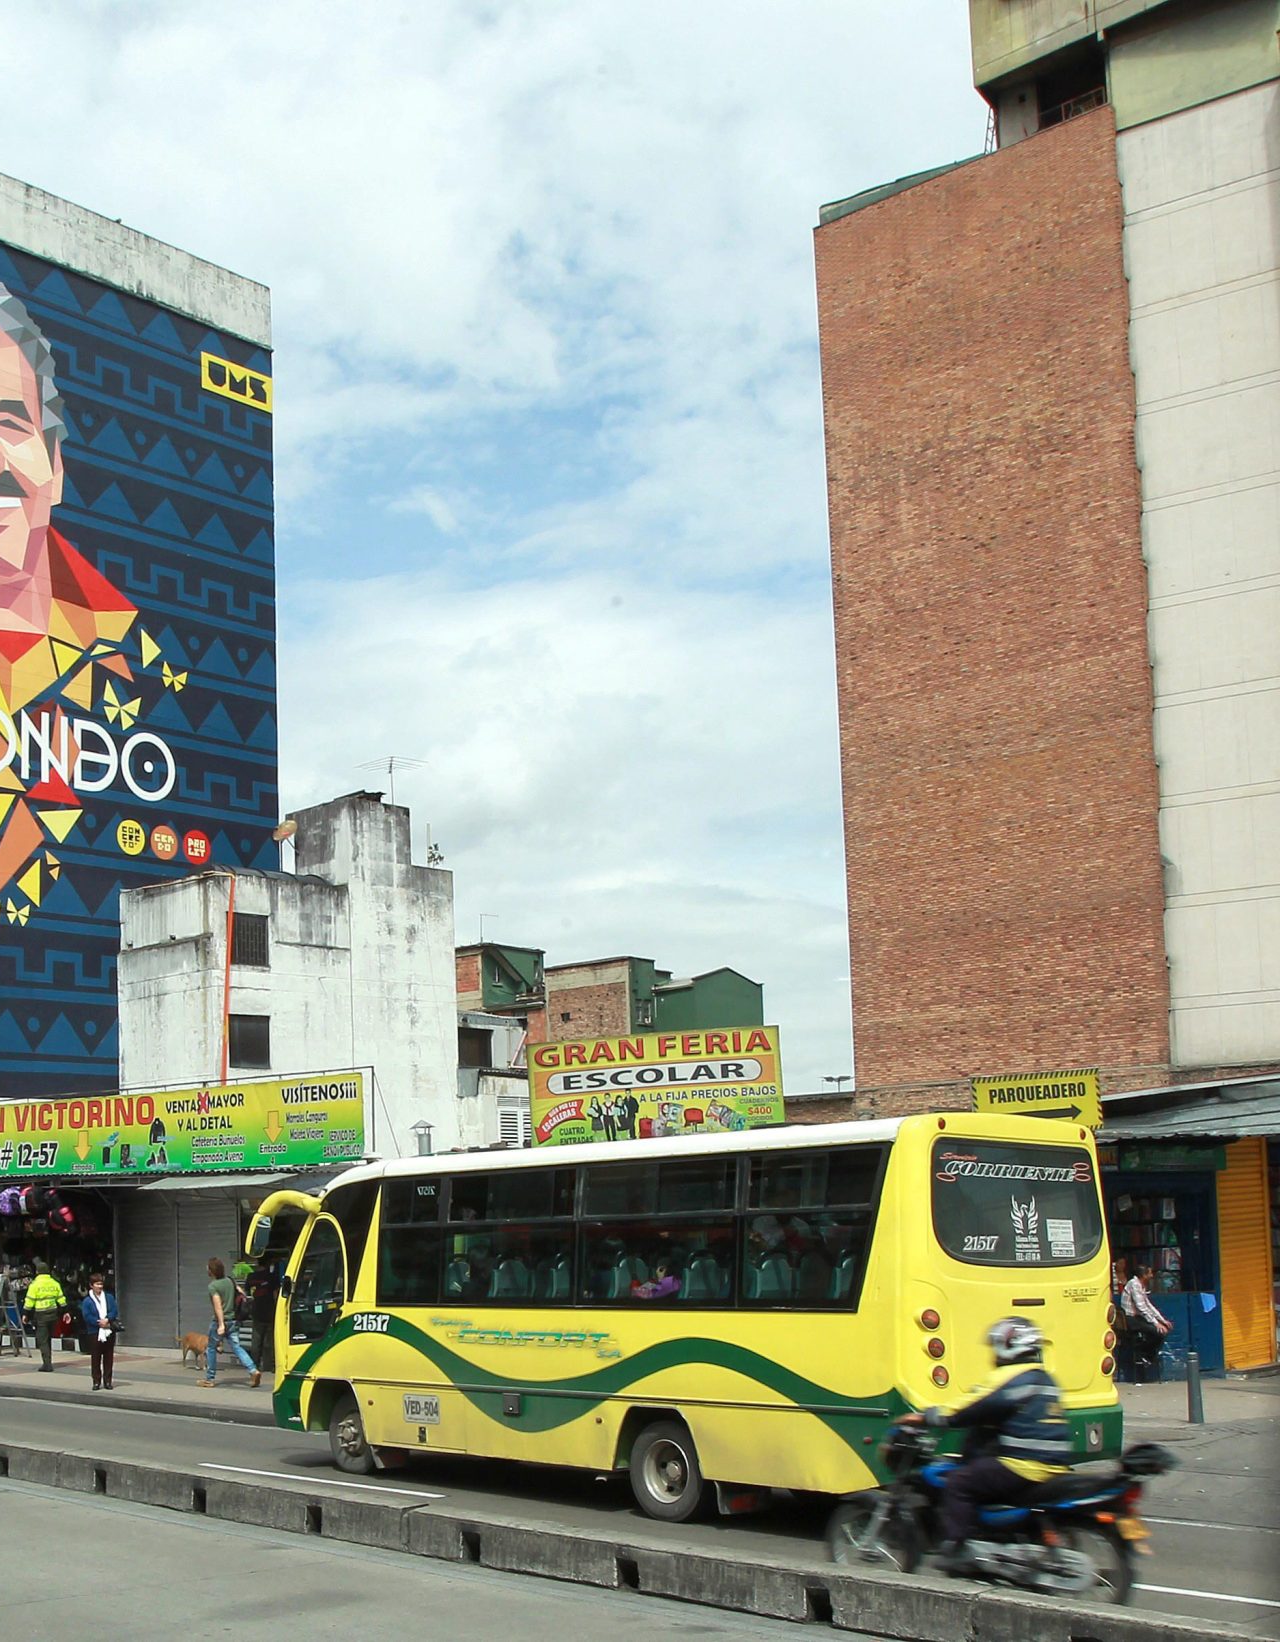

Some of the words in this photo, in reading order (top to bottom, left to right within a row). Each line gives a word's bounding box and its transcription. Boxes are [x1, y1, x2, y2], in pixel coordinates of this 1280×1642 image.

[534, 1036, 644, 1068] GRAN
[657, 1029, 772, 1057] FERIA
[563, 1062, 745, 1091] ESCOLAR
[207, 1093, 244, 1108] MAYOR
[640, 1094, 647, 1102] A
[649, 1093, 663, 1101] LA
[666, 1090, 688, 1101] FIJA
[691, 1087, 738, 1099] PRECIOS
[741, 1085, 777, 1096] BAJOS
[989, 1082, 1087, 1104] PARQUEADERO
[14, 1096, 155, 1132] VICTORINO
[748, 1106, 772, 1115] $400
[177, 1119, 184, 1132] Y
[186, 1118, 198, 1131] AL
[200, 1115, 233, 1130] DETAL
[17, 1143, 58, 1167] 12-57
[945, 1160, 1077, 1182] CORRIENTE
[963, 1236, 999, 1252] 21517
[353, 1313, 390, 1332] 21517
